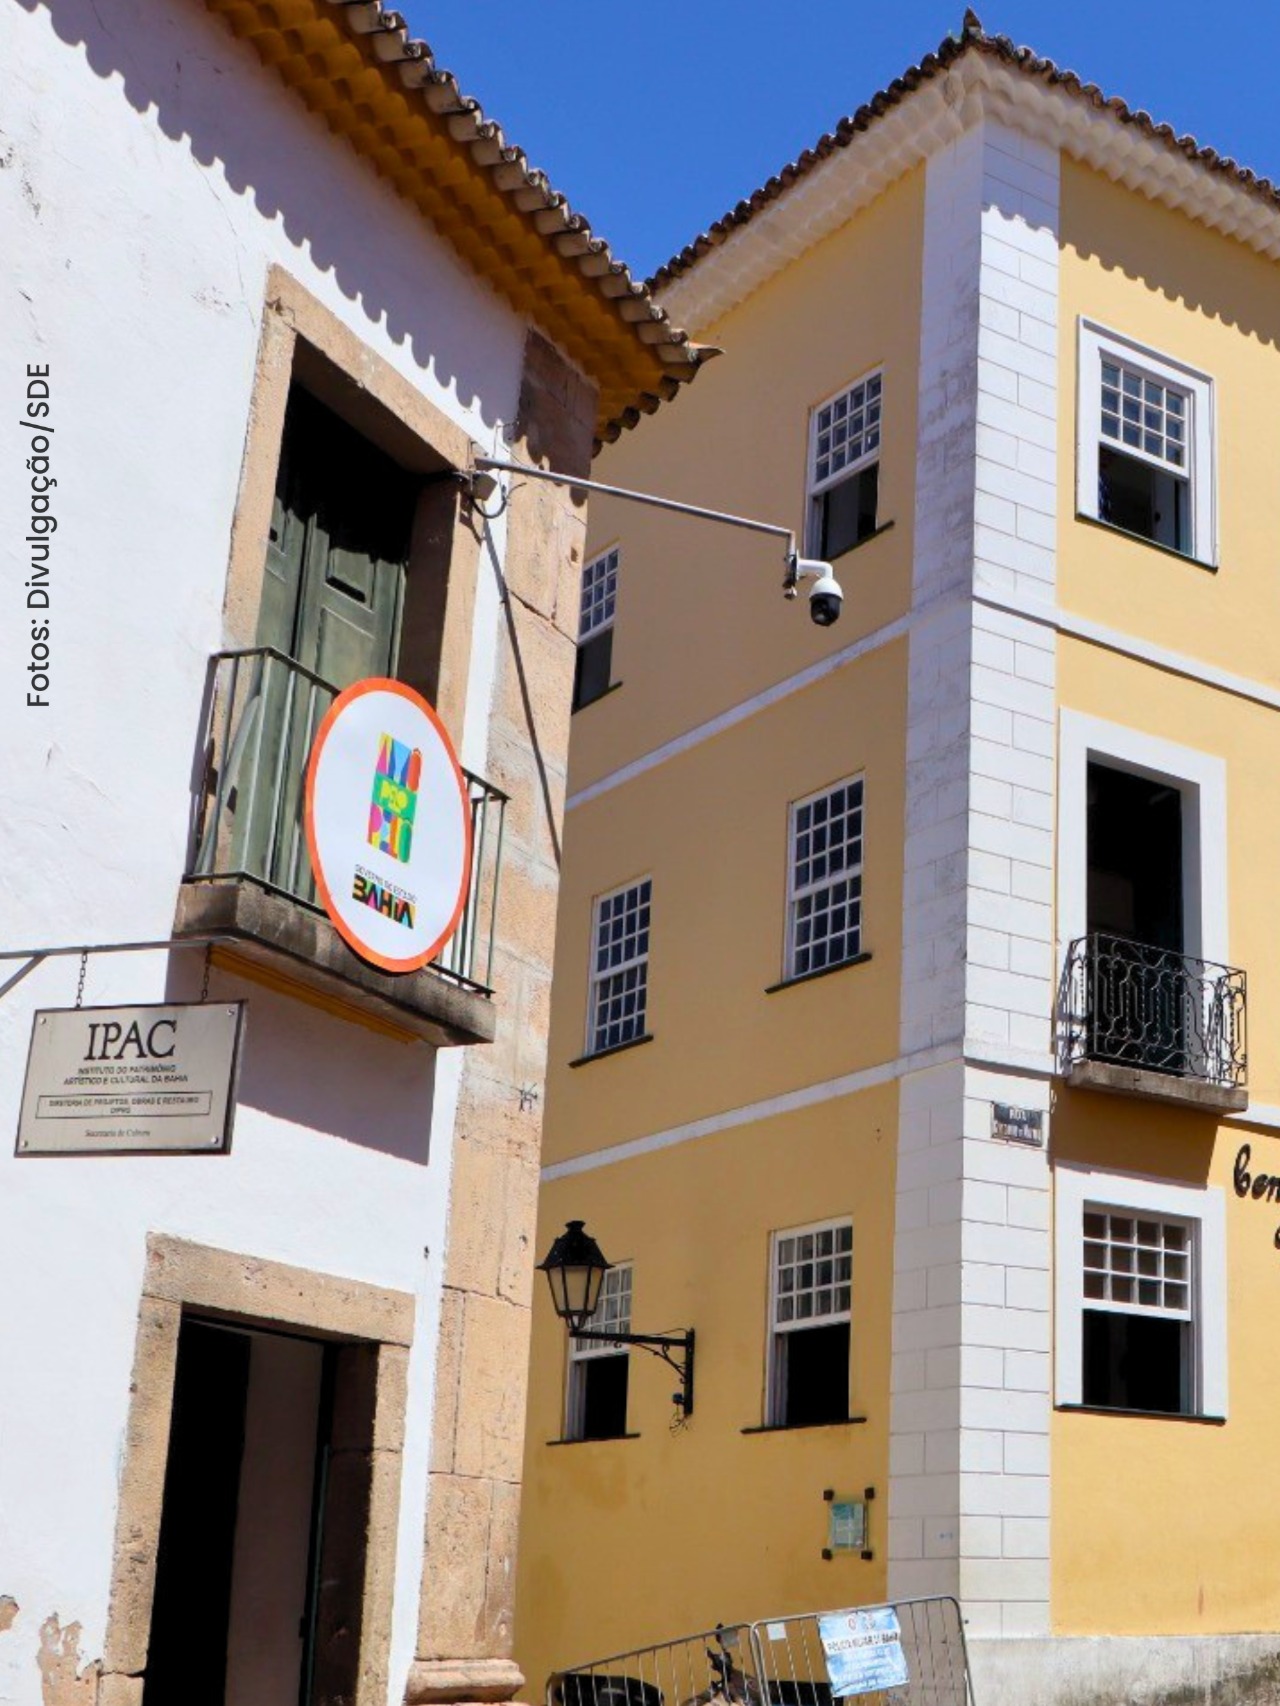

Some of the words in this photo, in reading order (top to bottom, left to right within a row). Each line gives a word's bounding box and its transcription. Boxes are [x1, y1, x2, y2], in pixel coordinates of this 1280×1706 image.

[84, 1020, 177, 1060] IPAC
[78, 1066, 114, 1075] INSTITUTO
[117, 1066, 127, 1074] DO
[110, 1076, 150, 1084] CULTURAL
[151, 1075, 162, 1083] DA
